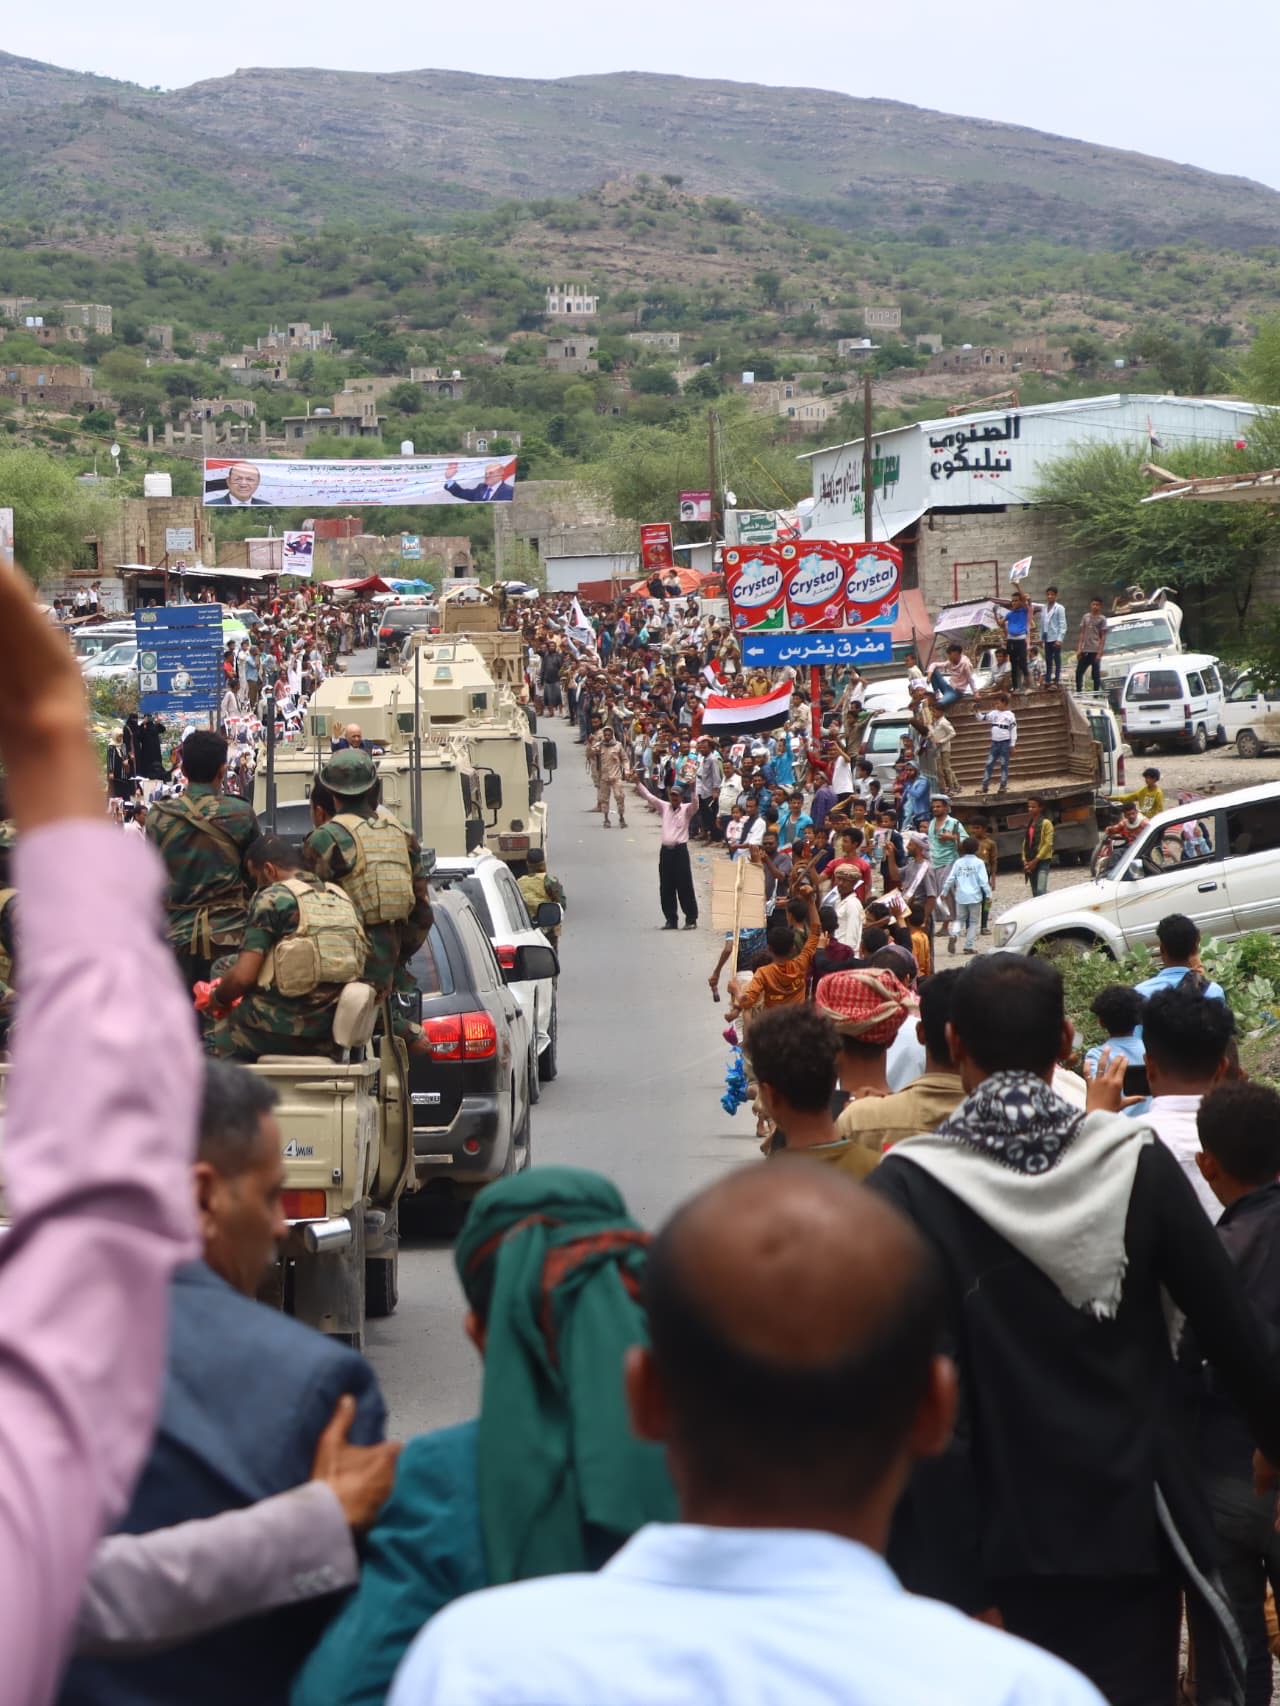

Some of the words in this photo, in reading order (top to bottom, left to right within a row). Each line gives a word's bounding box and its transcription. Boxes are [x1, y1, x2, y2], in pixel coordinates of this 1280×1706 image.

[929, 416, 1020, 454] الصنوي
[930, 448, 1012, 480] تيليكوم
[733, 570, 779, 599] Crystal
[789, 566, 839, 596] Crystal
[847, 566, 893, 594] Crystal
[778, 639, 835, 660] يفرس
[837, 637, 885, 657] مفرق
